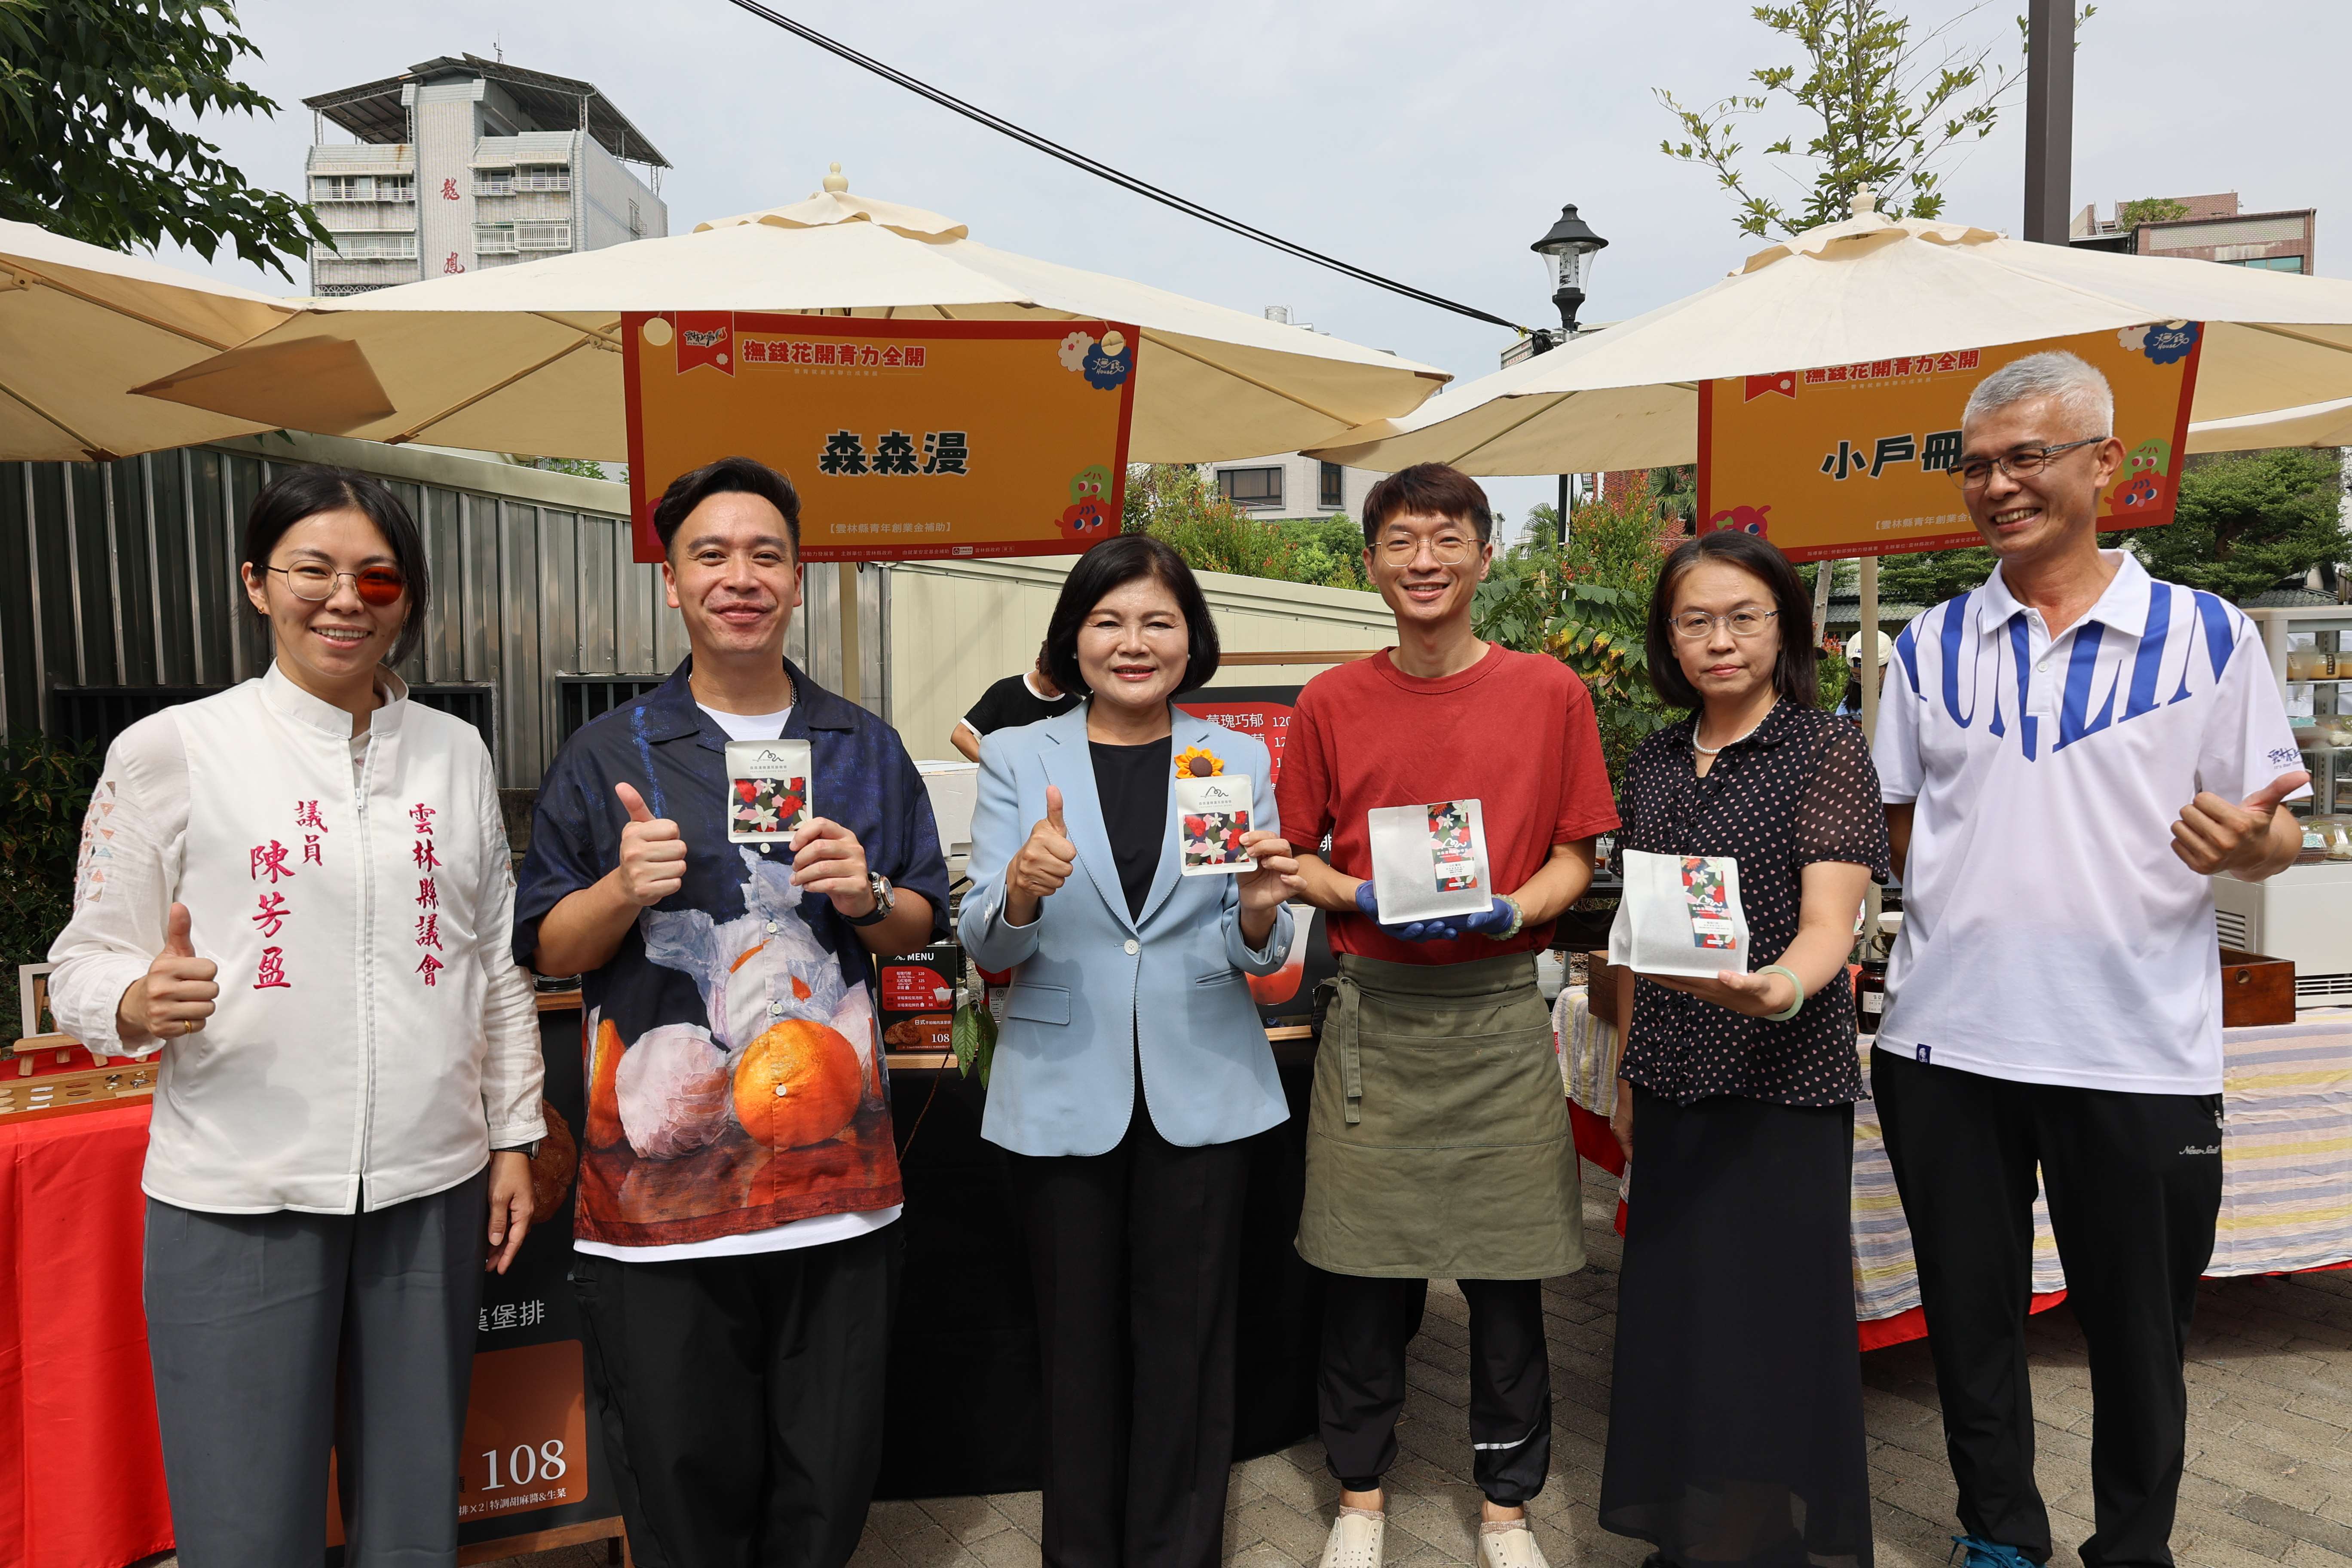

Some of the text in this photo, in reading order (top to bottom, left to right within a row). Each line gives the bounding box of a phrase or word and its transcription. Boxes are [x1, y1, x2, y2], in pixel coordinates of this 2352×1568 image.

[742, 340, 927, 368] 撫錢花開青力全開
[1805, 349, 1980, 384] 撫錢花開青力全開
[818, 428, 971, 478] 森森漫
[1819, 429, 1963, 481] 小戶冊
[830, 521, 951, 534] 【雲林縣青年創業金補助】
[294, 800, 328, 867] 議員
[250, 839, 296, 990] 陳芳盈
[409, 803, 444, 987] 雲林縣議會
[931, 1033, 949, 1043] 108
[481, 1439, 567, 1491] 108
